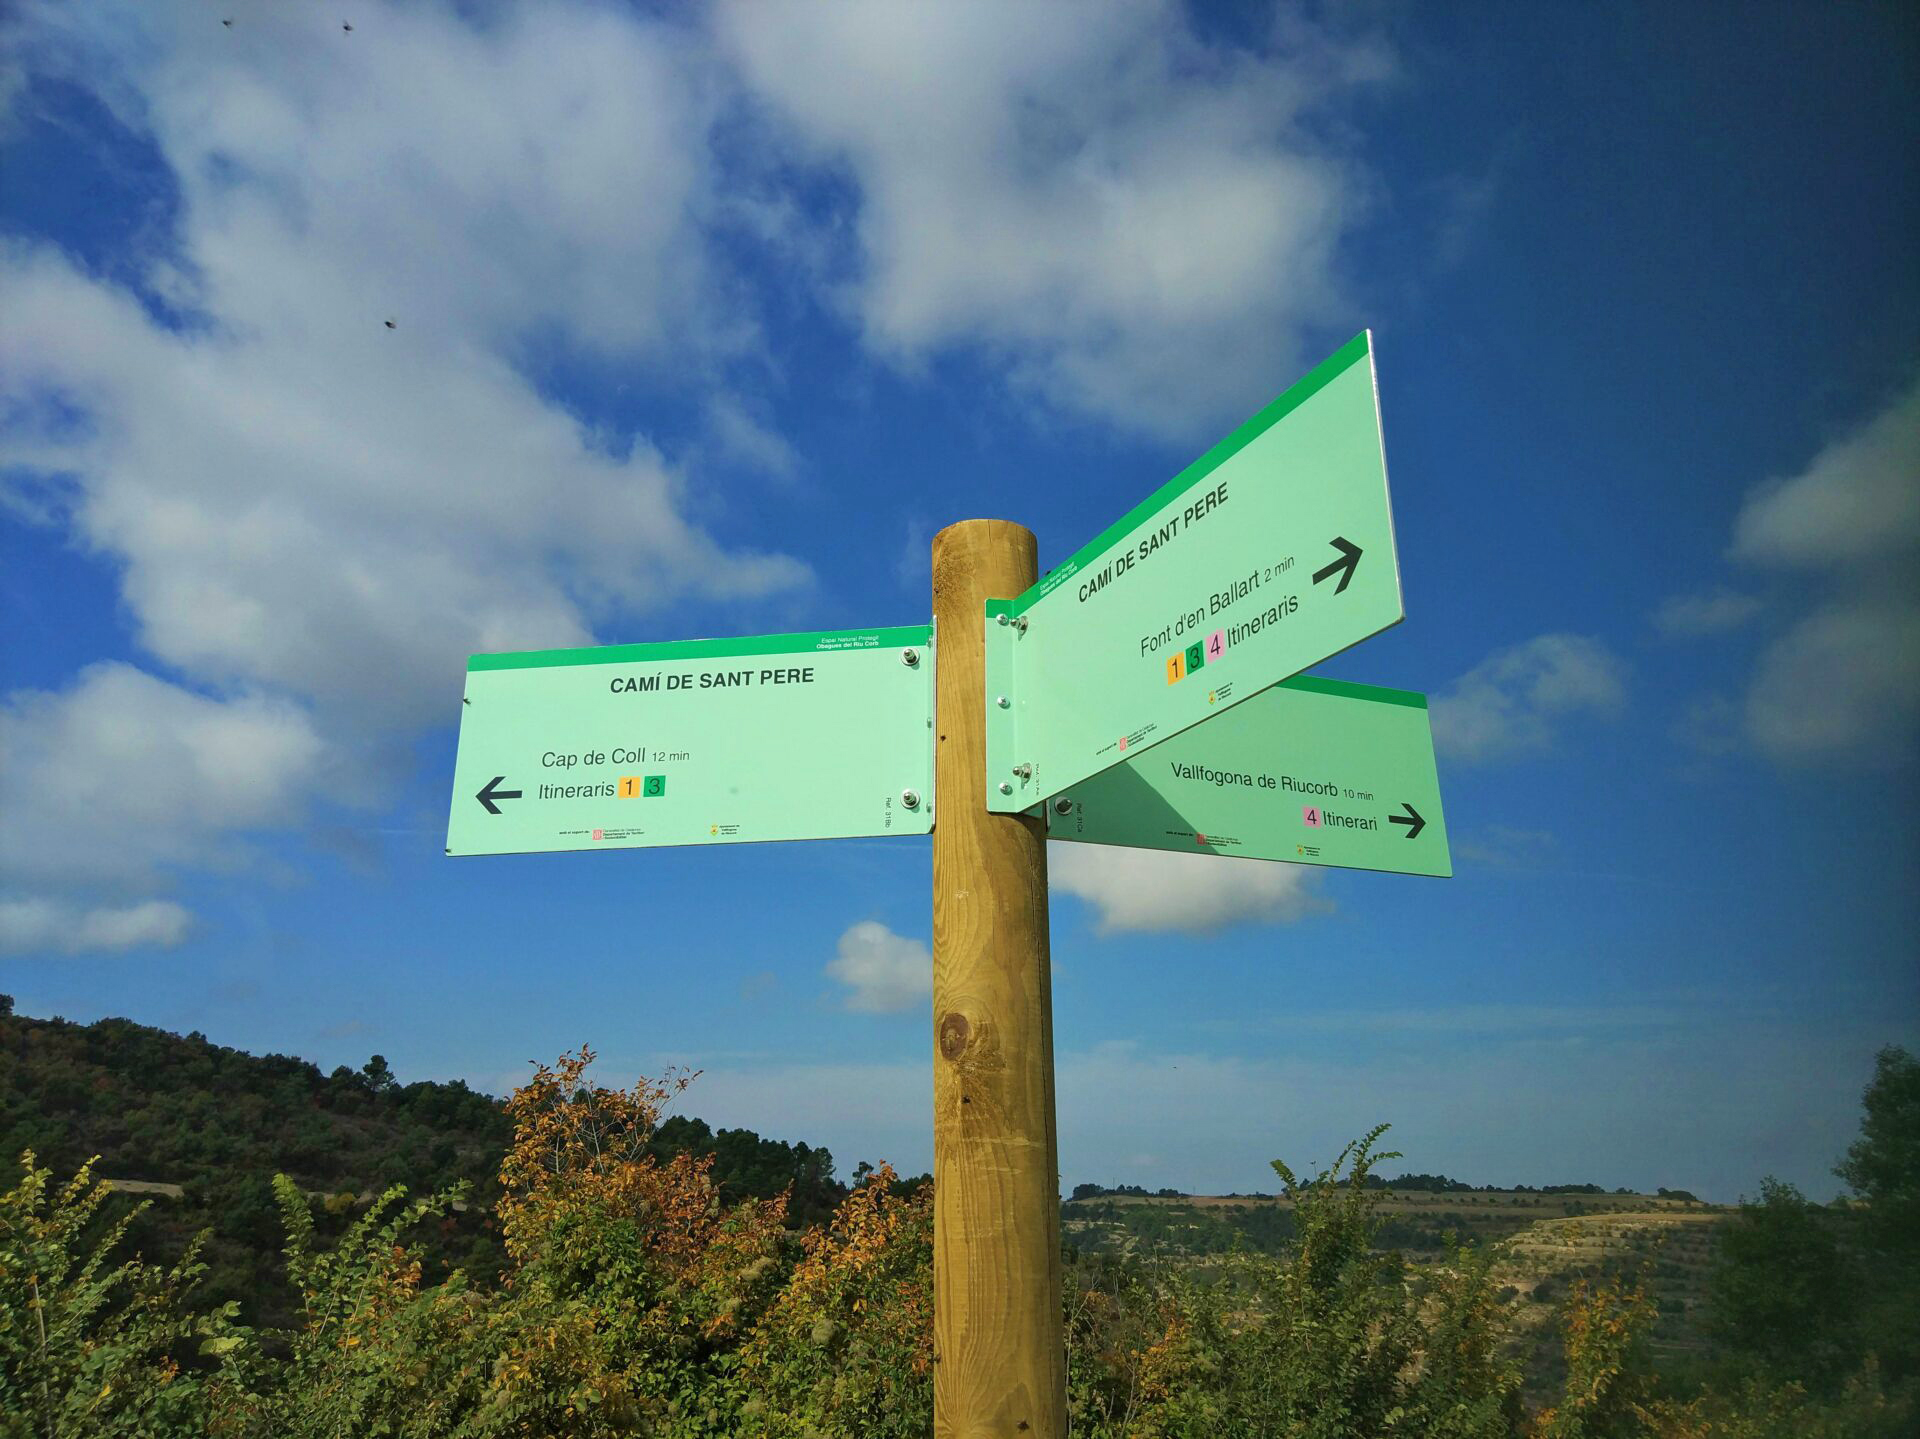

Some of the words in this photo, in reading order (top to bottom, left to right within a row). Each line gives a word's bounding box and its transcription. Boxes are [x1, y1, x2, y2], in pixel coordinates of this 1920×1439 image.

[1078, 560, 1113, 603] CAMÍ
[1116, 549, 1136, 578] DE
[1139, 516, 1180, 561] SANT
[1184, 481, 1229, 529] PERE
[1140, 625, 1171, 658] Font
[1175, 607, 1205, 636] d'en
[1209, 570, 1260, 616] Ballart
[1264, 568, 1272, 583] 2
[1274, 556, 1295, 577] min
[1171, 658, 1178, 678] 1
[1190, 647, 1200, 669] 3
[1210, 634, 1221, 655] 4
[1227, 595, 1299, 648] Itineraris
[610, 672, 662, 693] CAMÍ
[666, 674, 693, 691] DE
[699, 671, 754, 689] SANT
[760, 667, 815, 685] PERE
[541, 752, 578, 770] Cap
[583, 750, 606, 766] de
[611, 747, 646, 764] Coll
[652, 752, 666, 762] 12
[669, 750, 690, 761] min
[538, 781, 615, 800] Itineraris
[625, 779, 632, 795] 1
[648, 778, 660, 795] 3
[1171, 762, 1253, 787] Vallfogona
[1258, 774, 1277, 789] de
[1281, 775, 1339, 797] Riucorb
[1343, 788, 1355, 799] 10
[1357, 791, 1374, 801] min
[1307, 809, 1318, 825] 4
[1323, 811, 1378, 831] Itinerari
